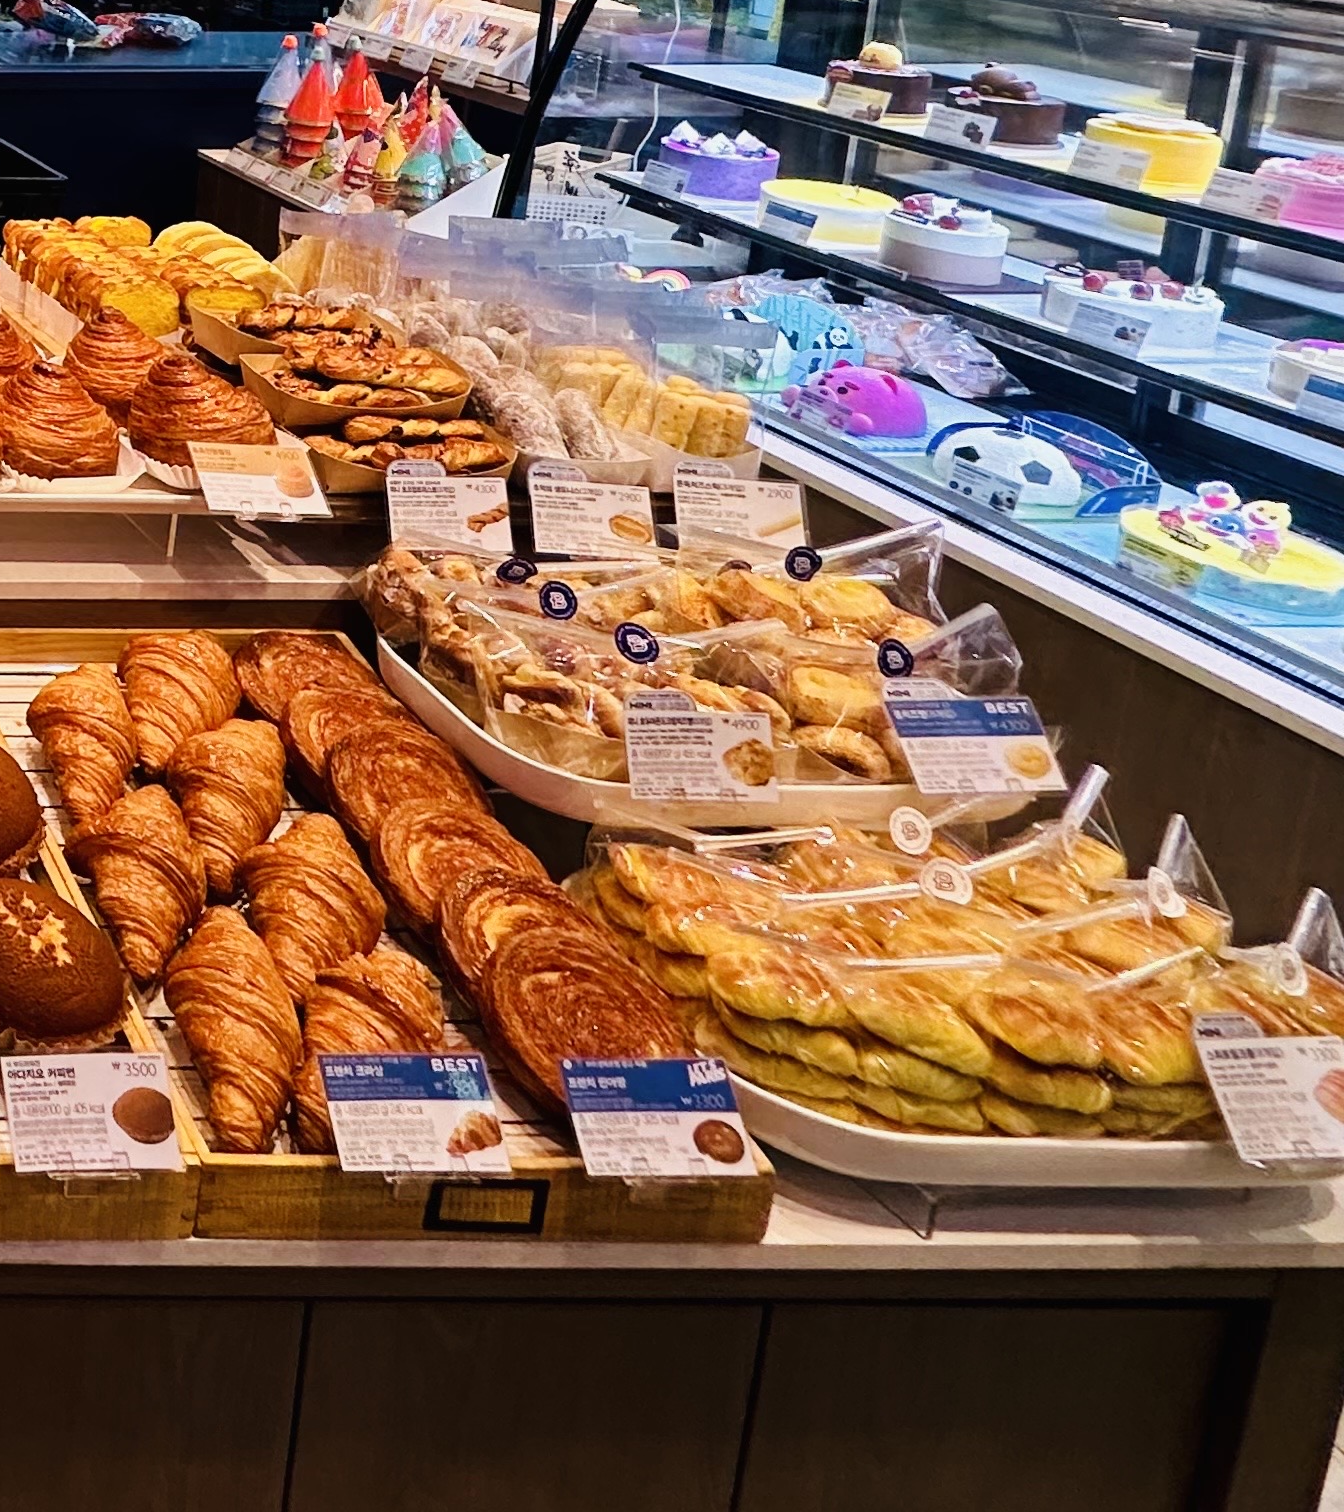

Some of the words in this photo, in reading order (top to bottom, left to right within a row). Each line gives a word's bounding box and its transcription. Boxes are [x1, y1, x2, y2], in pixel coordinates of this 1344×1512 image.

[984, 701, 1029, 714] BEST
[124, 1062, 158, 1077] 3500
[430, 1058, 479, 1072] BEST
